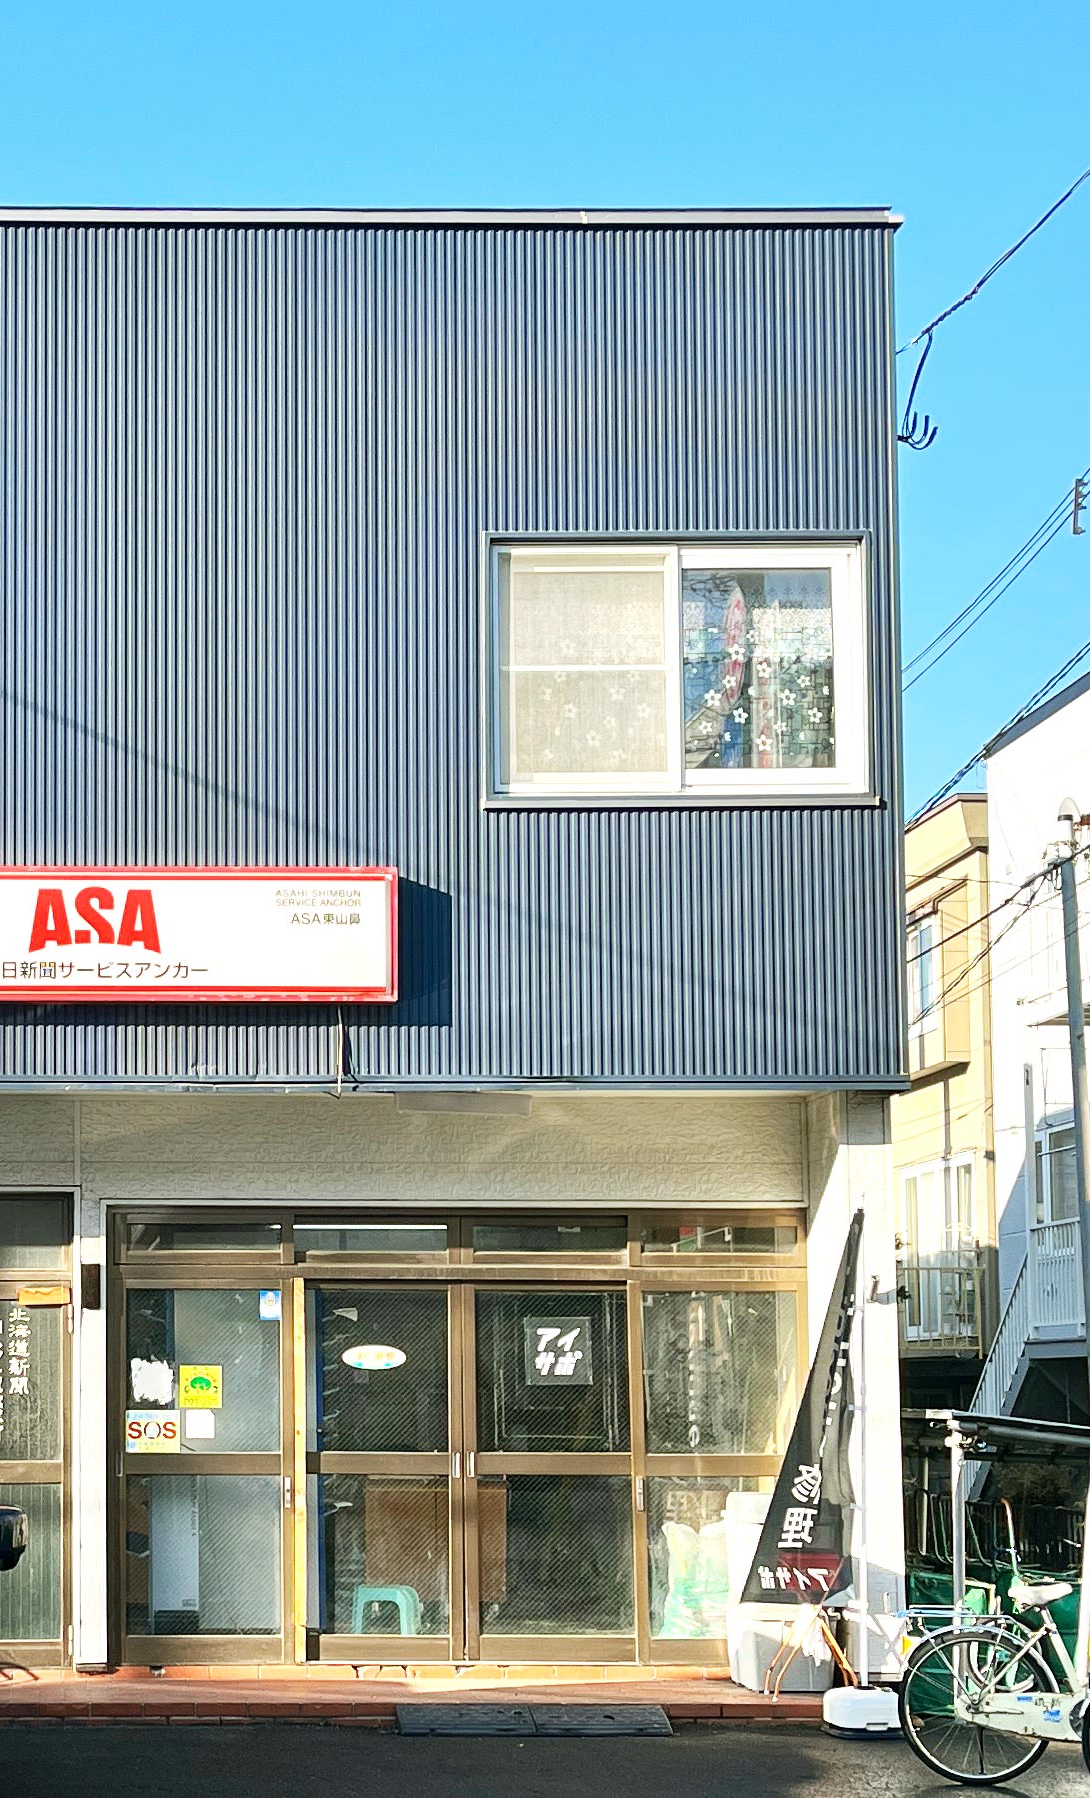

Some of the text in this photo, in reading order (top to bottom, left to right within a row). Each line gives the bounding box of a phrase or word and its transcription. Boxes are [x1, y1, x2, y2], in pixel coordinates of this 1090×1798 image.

[275, 889, 361, 898] ASAHI SHIMBUN
[276, 898, 361, 907] SERVICE ANCHOR
[28, 887, 161, 954] ASA
[536, 1328, 581, 1351] アイ
[8, 1308, 31, 1395] 北海道新聞
[535, 1350, 583, 1376] サポ
[127, 1421, 177, 1439] SOS
